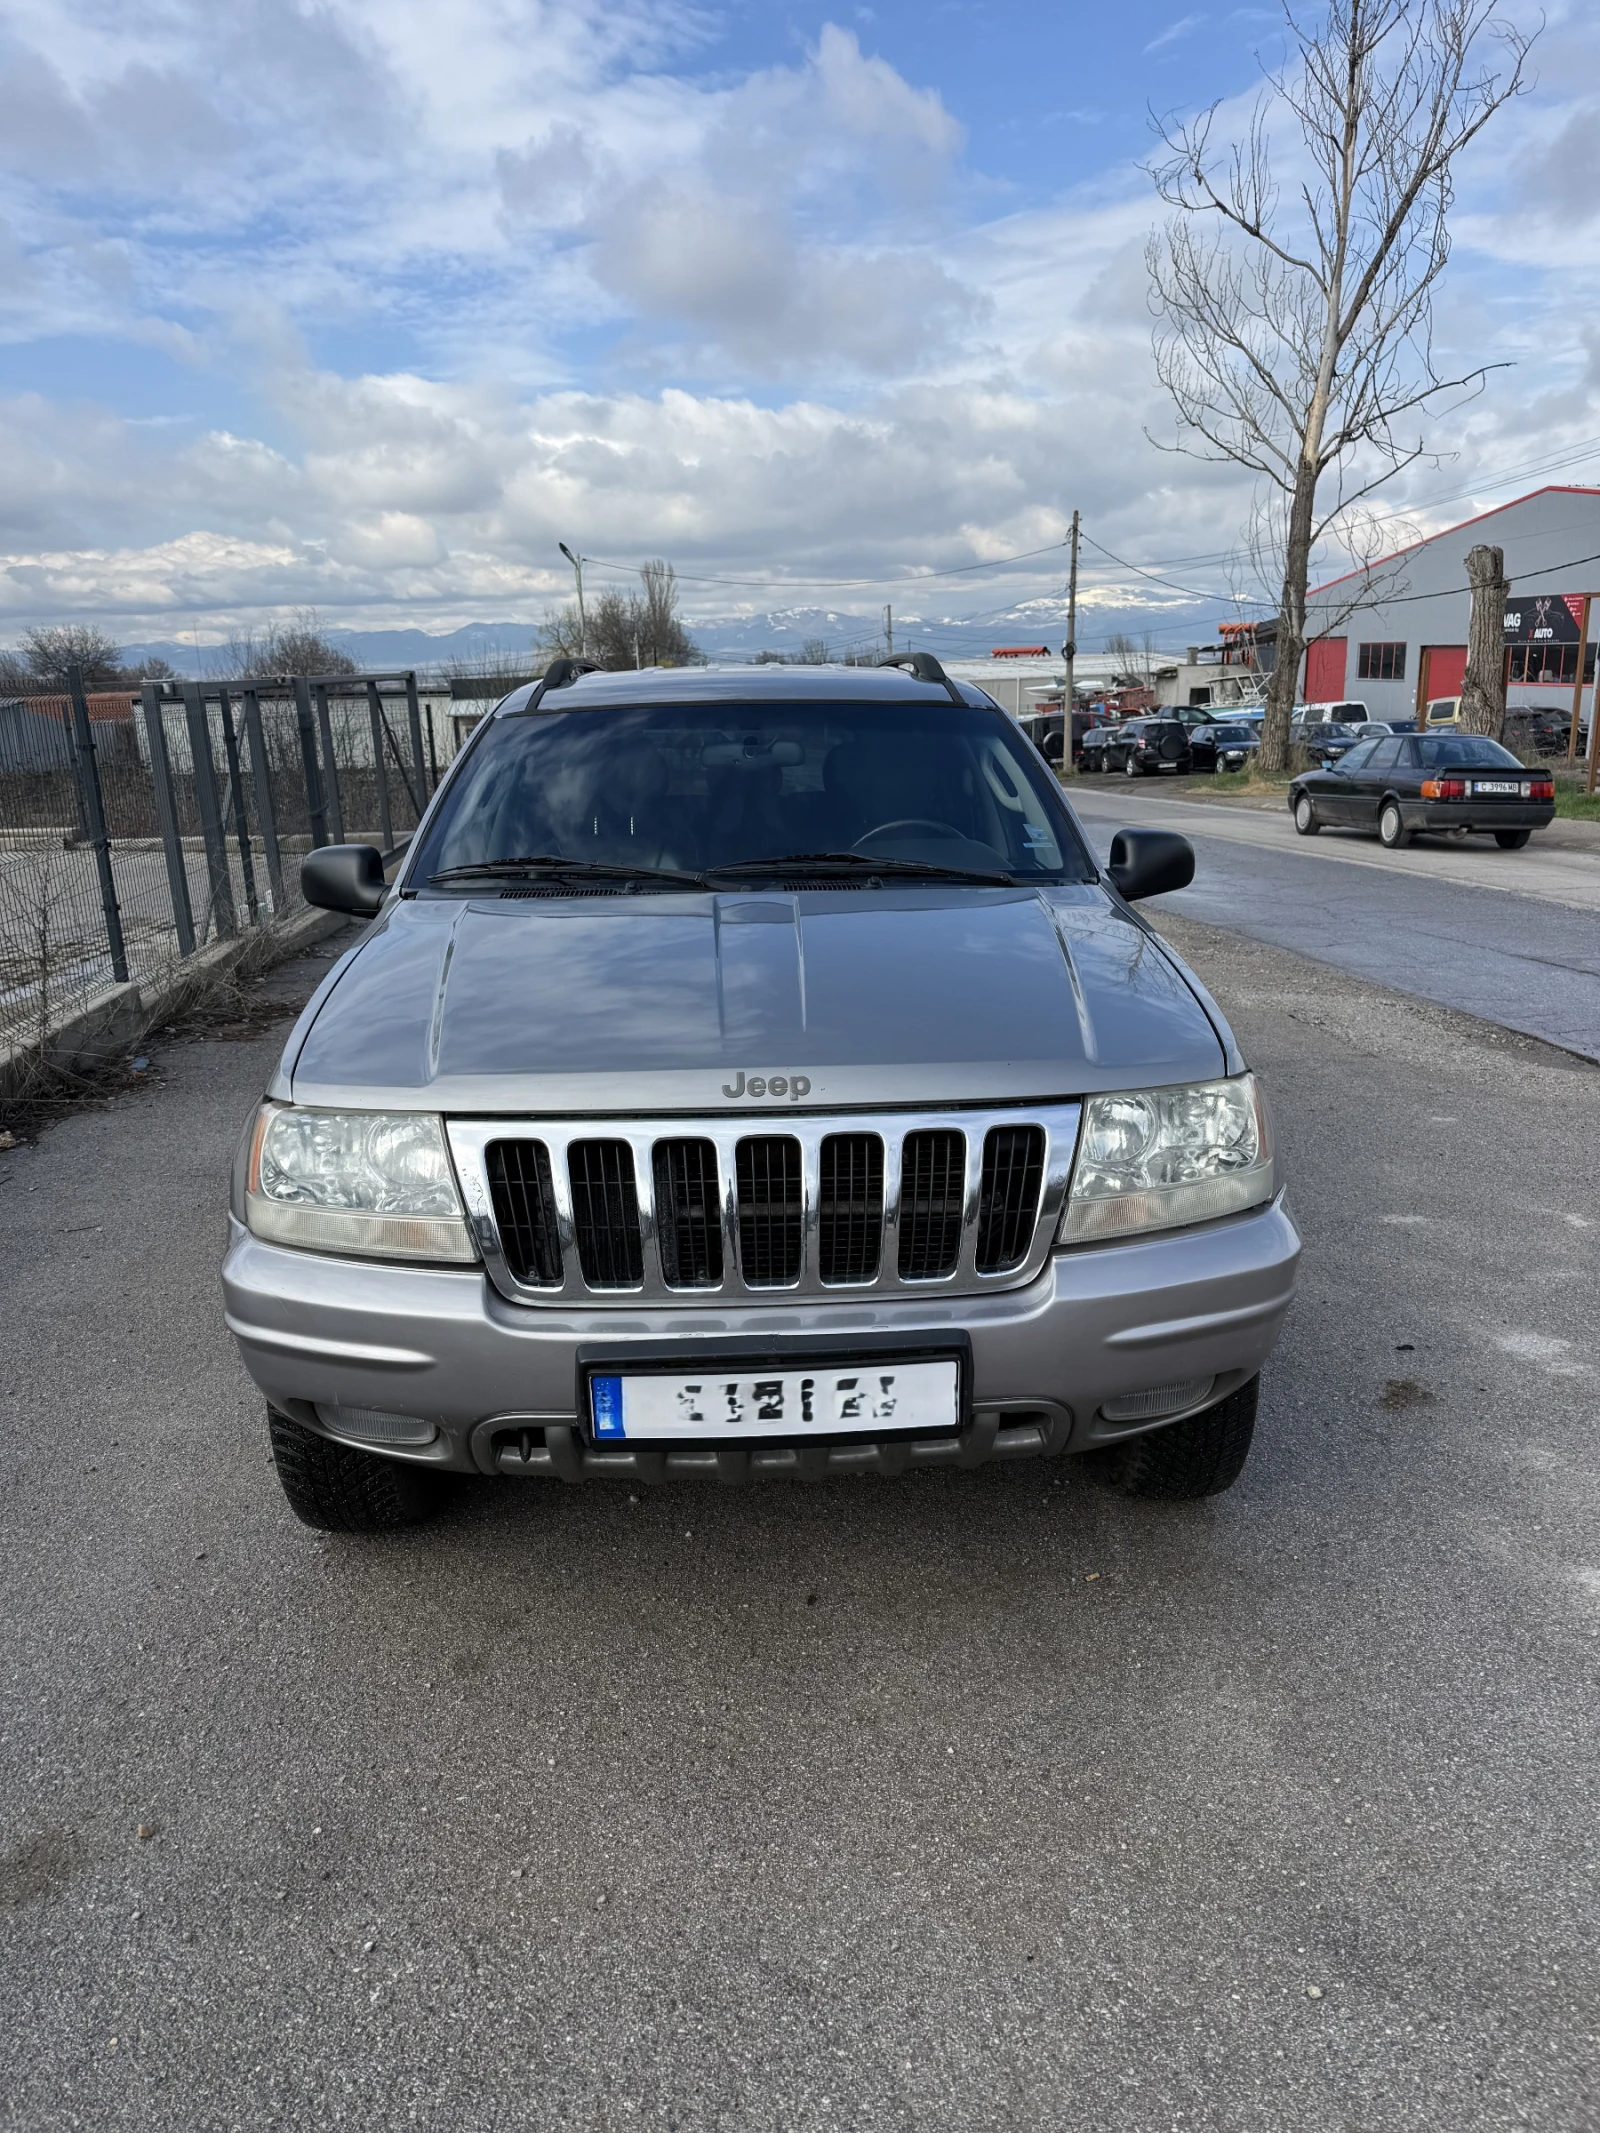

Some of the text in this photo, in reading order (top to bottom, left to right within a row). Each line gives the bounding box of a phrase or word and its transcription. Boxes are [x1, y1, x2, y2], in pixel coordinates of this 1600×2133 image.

[1504, 613, 1521, 627] VAG
[1534, 628, 1553, 638] AUTO
[722, 1072, 811, 1101] Jeep
